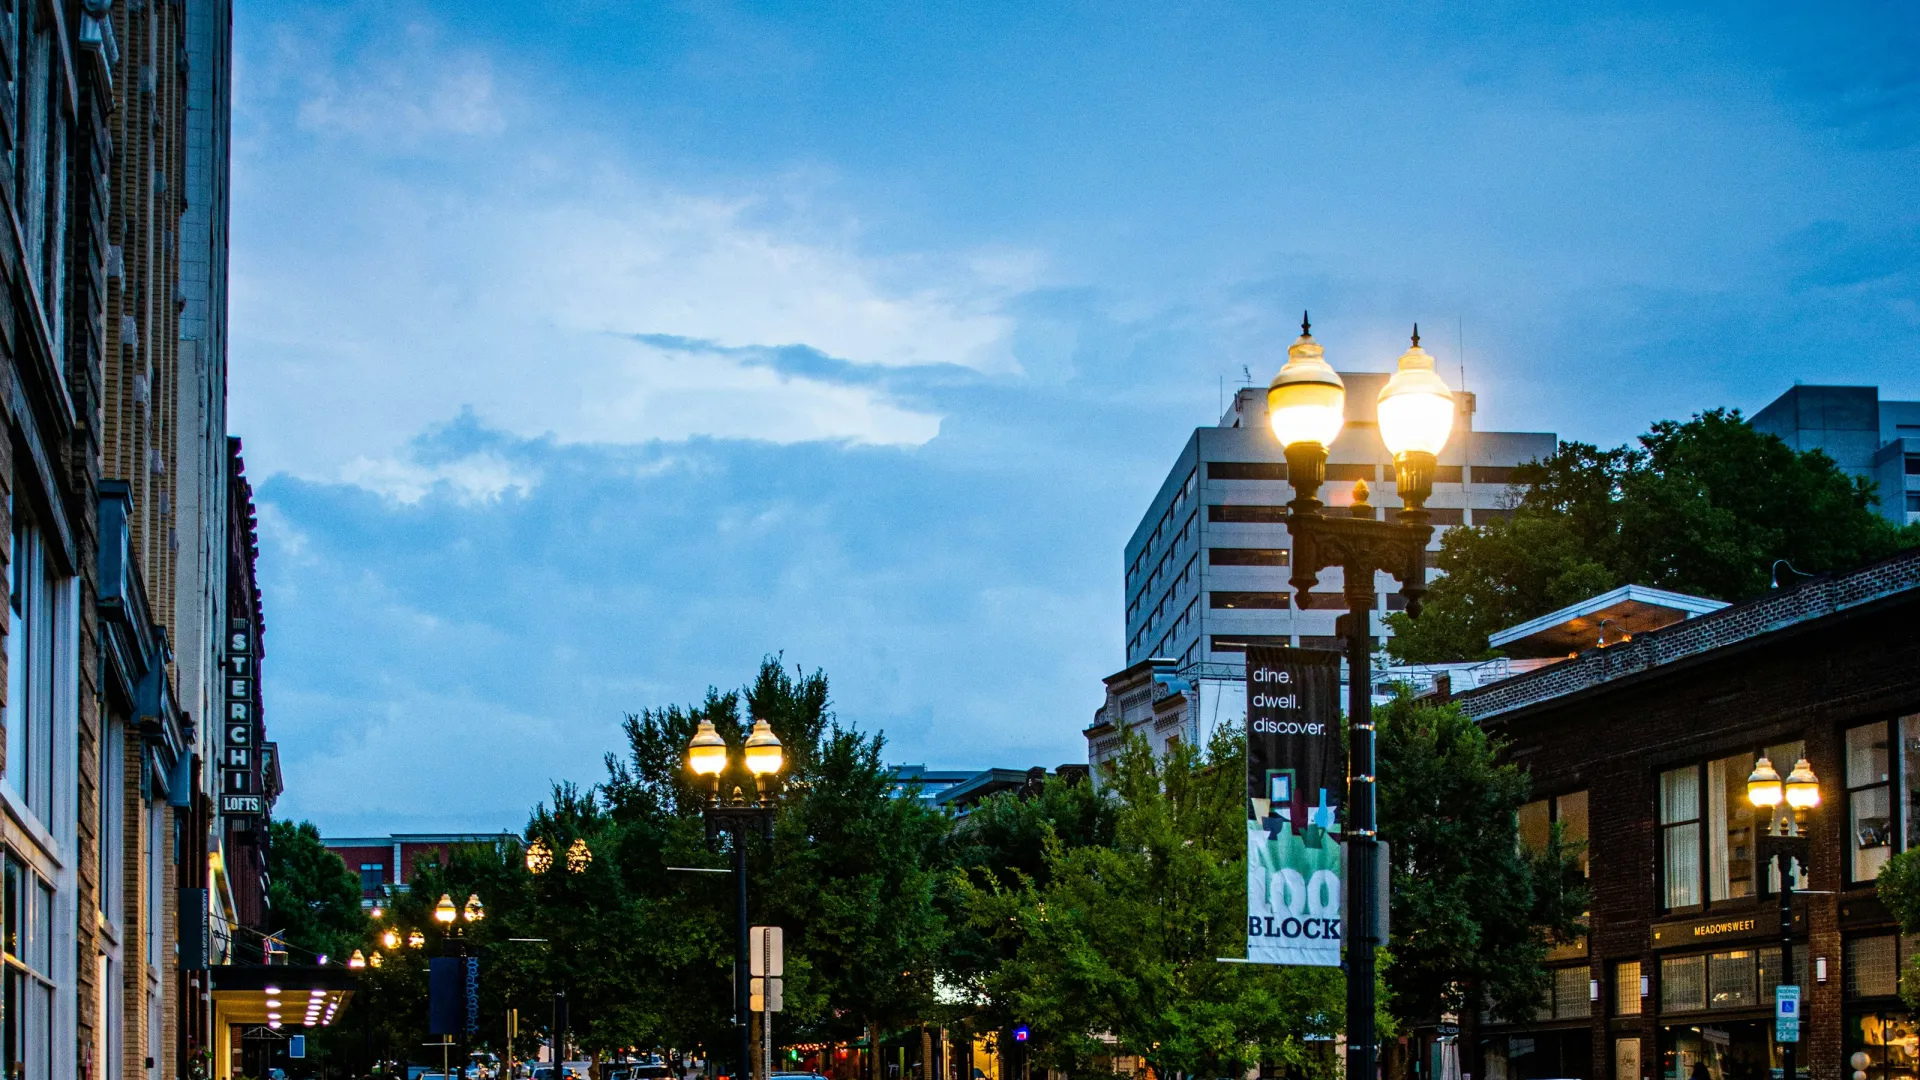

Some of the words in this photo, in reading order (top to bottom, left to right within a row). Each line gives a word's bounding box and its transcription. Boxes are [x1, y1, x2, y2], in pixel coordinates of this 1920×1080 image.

[1253, 667, 1293, 684] dine.
[1253, 693, 1301, 709] dwell.
[231, 634, 247, 789] STERCHI
[1253, 717, 1327, 736] discover.
[224, 797, 259, 811] LOFTS
[1248, 915, 1341, 940] BLOCK
[1694, 920, 1755, 936] MEADOWSWEET
